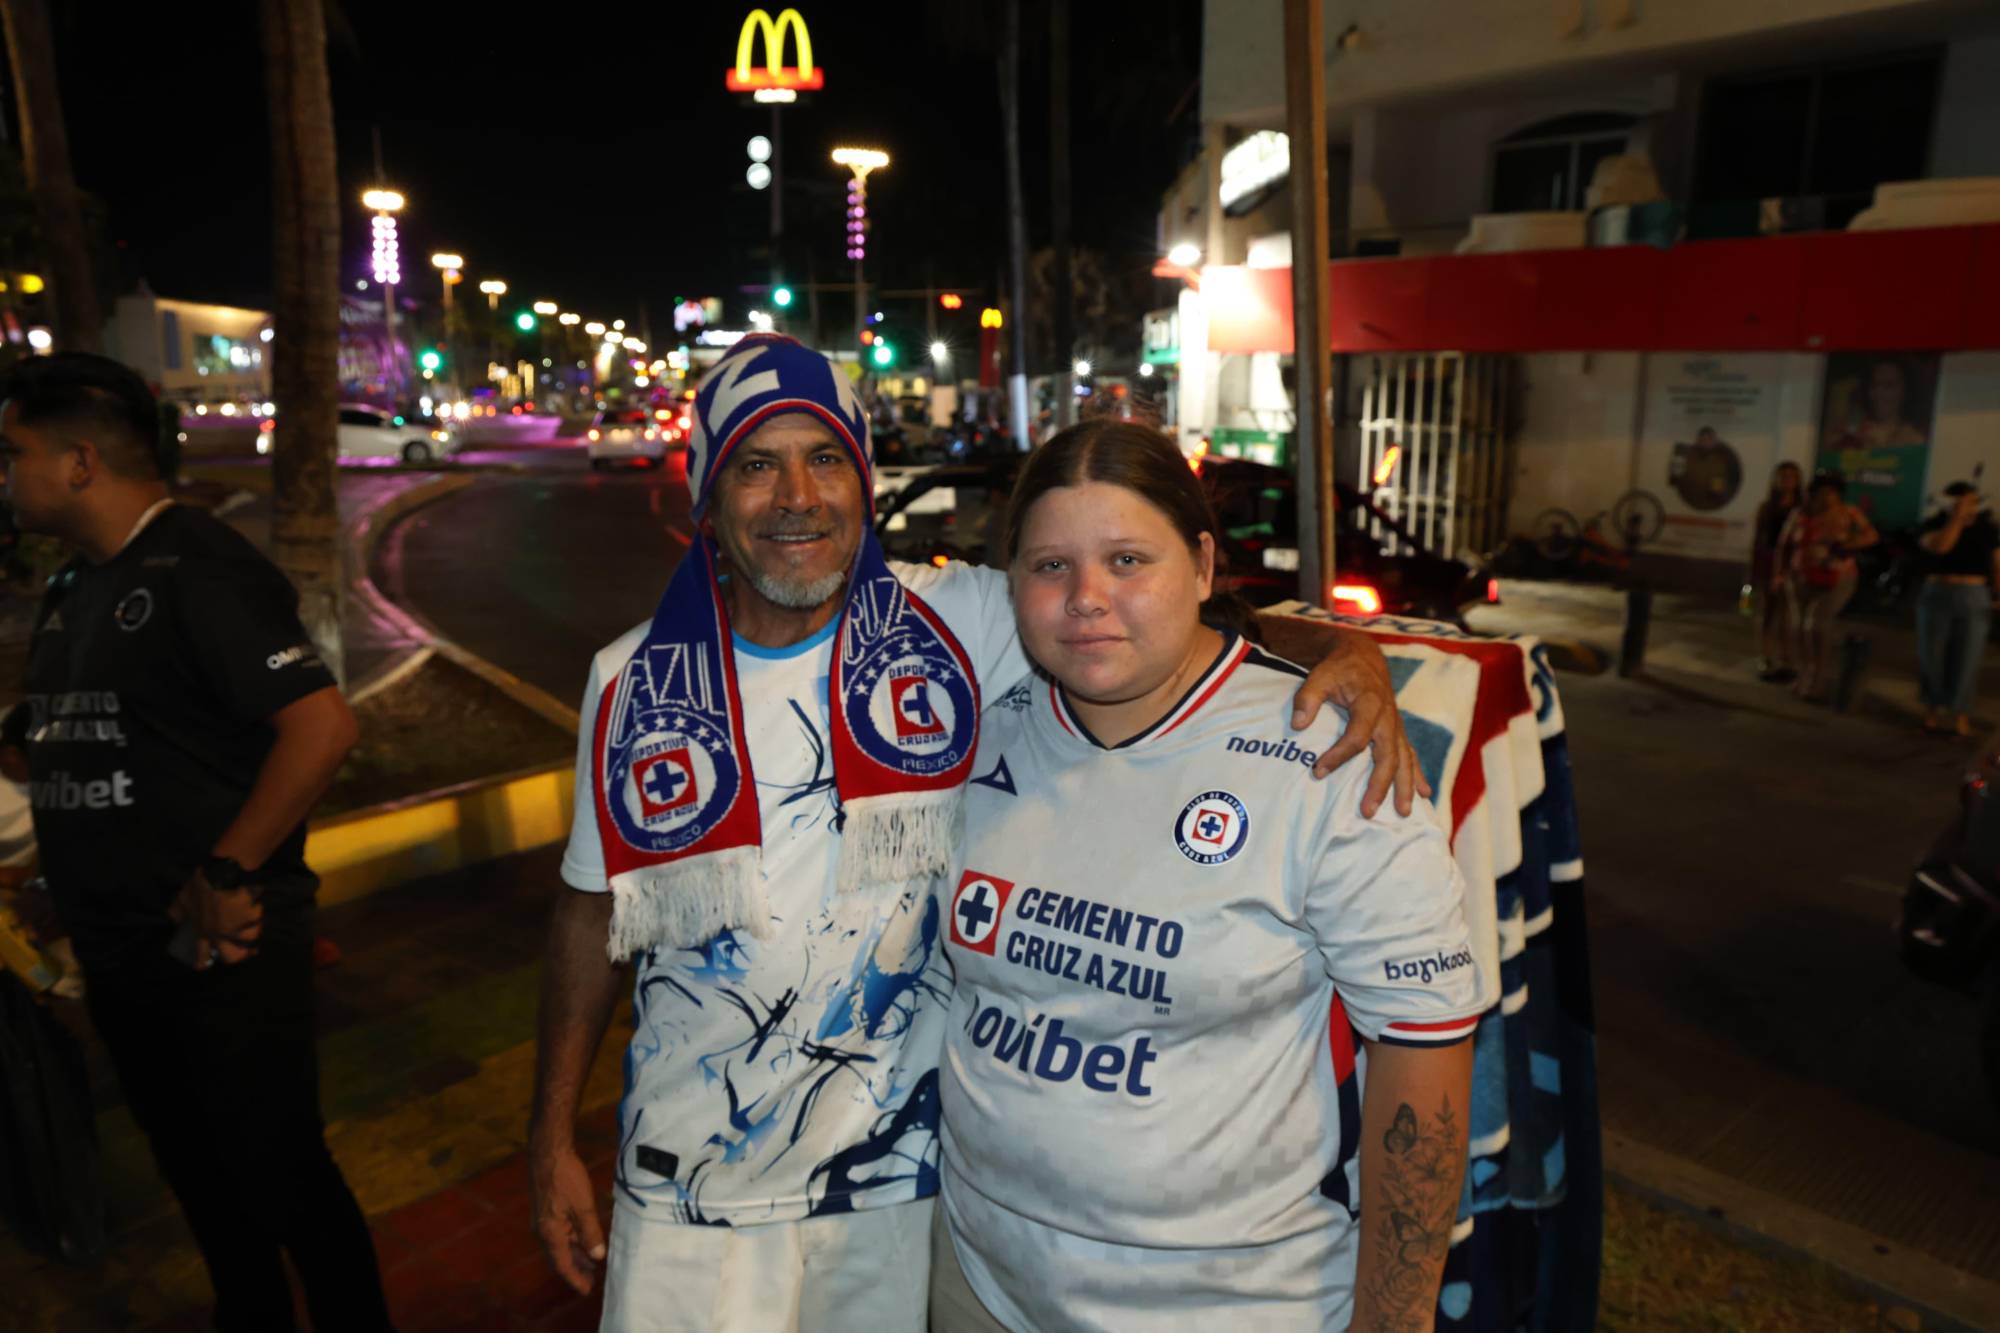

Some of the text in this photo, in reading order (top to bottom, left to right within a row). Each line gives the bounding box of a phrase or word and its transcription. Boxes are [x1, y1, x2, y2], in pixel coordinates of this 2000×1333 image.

[735, 8, 814, 84] M
[1226, 736, 1318, 768] novibe
[1015, 887, 1184, 959] CEMENTO
[964, 993, 1158, 1097] ovibet
